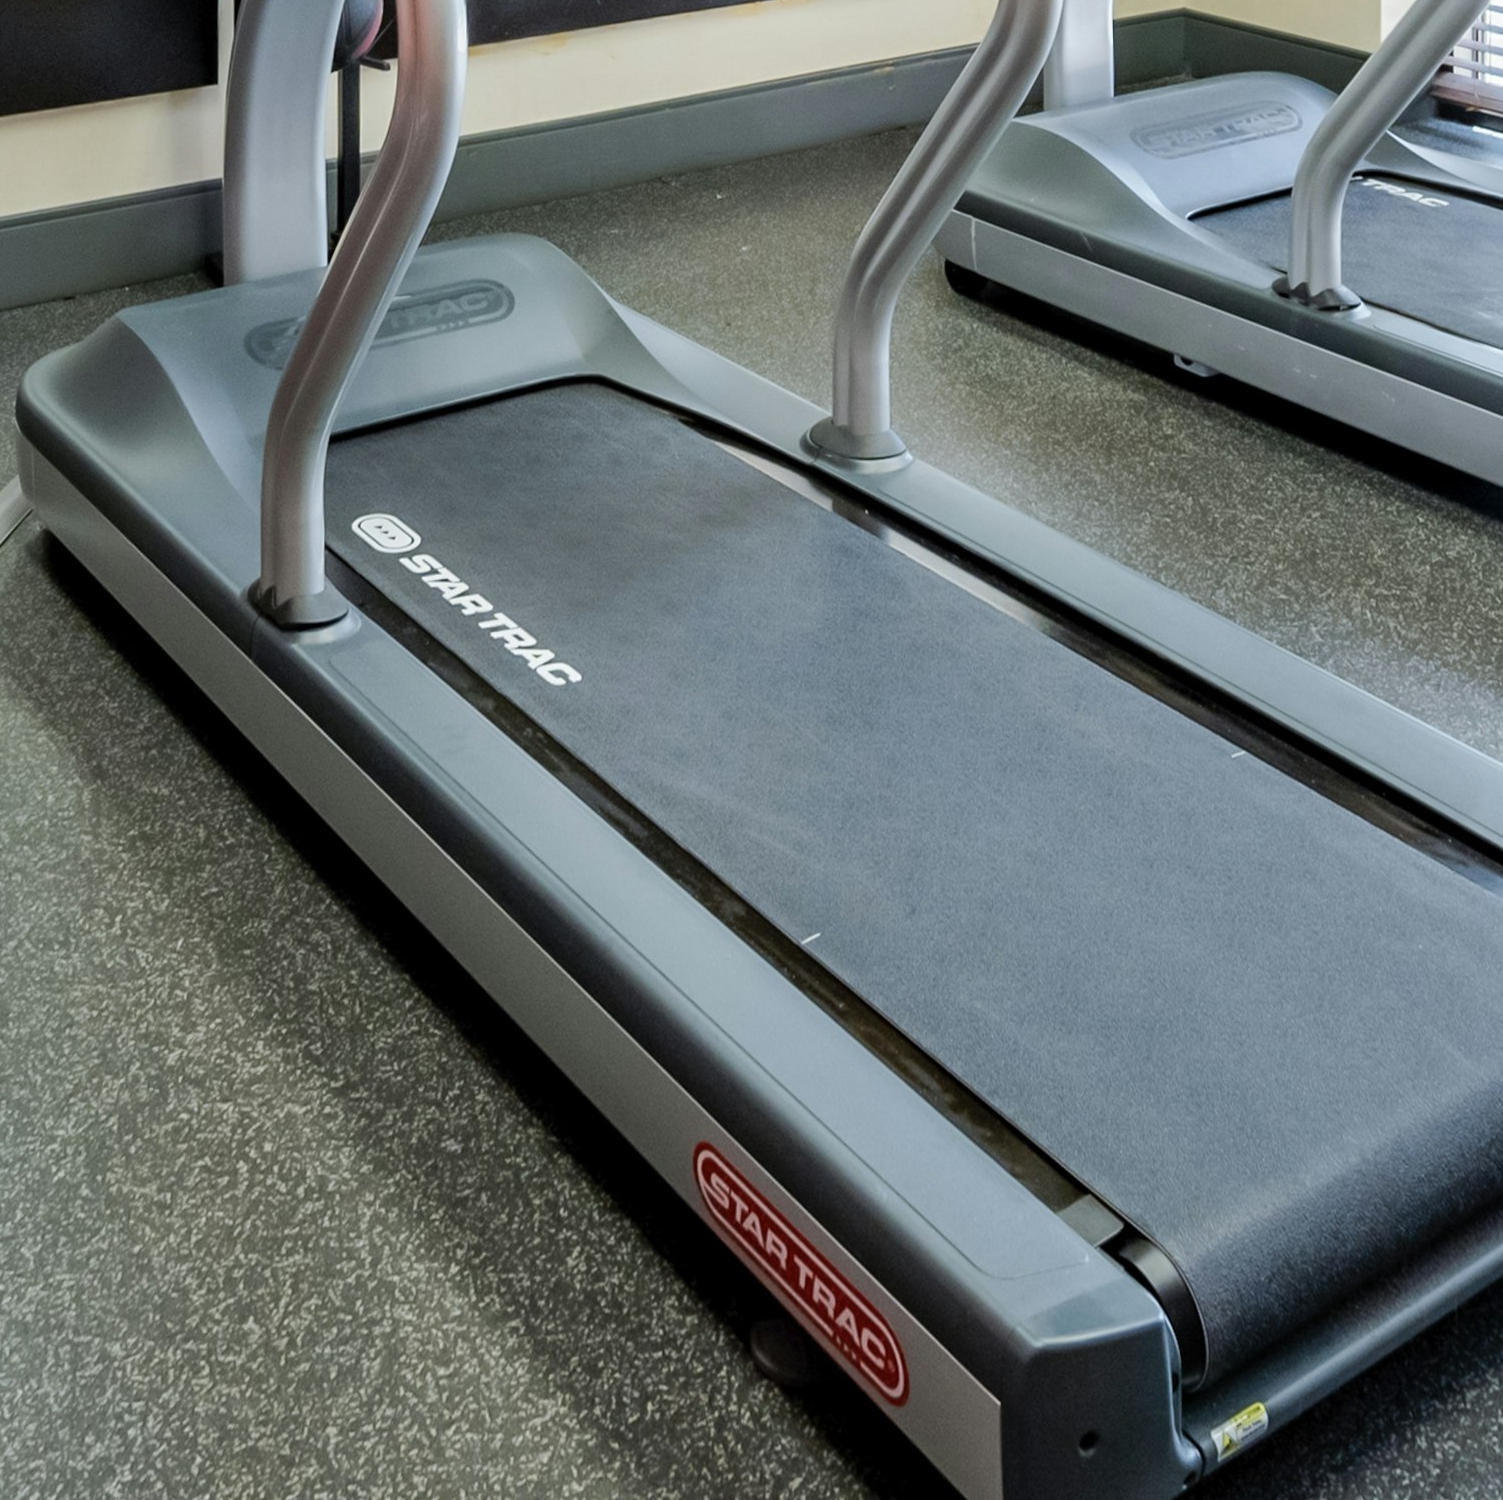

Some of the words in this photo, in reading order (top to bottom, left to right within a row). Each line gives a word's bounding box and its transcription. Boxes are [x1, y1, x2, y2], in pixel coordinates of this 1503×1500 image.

[1362, 179, 1449, 207] TRAC
[399, 554, 493, 616] STAR
[478, 612, 582, 686] TRAC
[704, 1172, 788, 1269] STAR
[794, 1255, 886, 1370] TRAC
